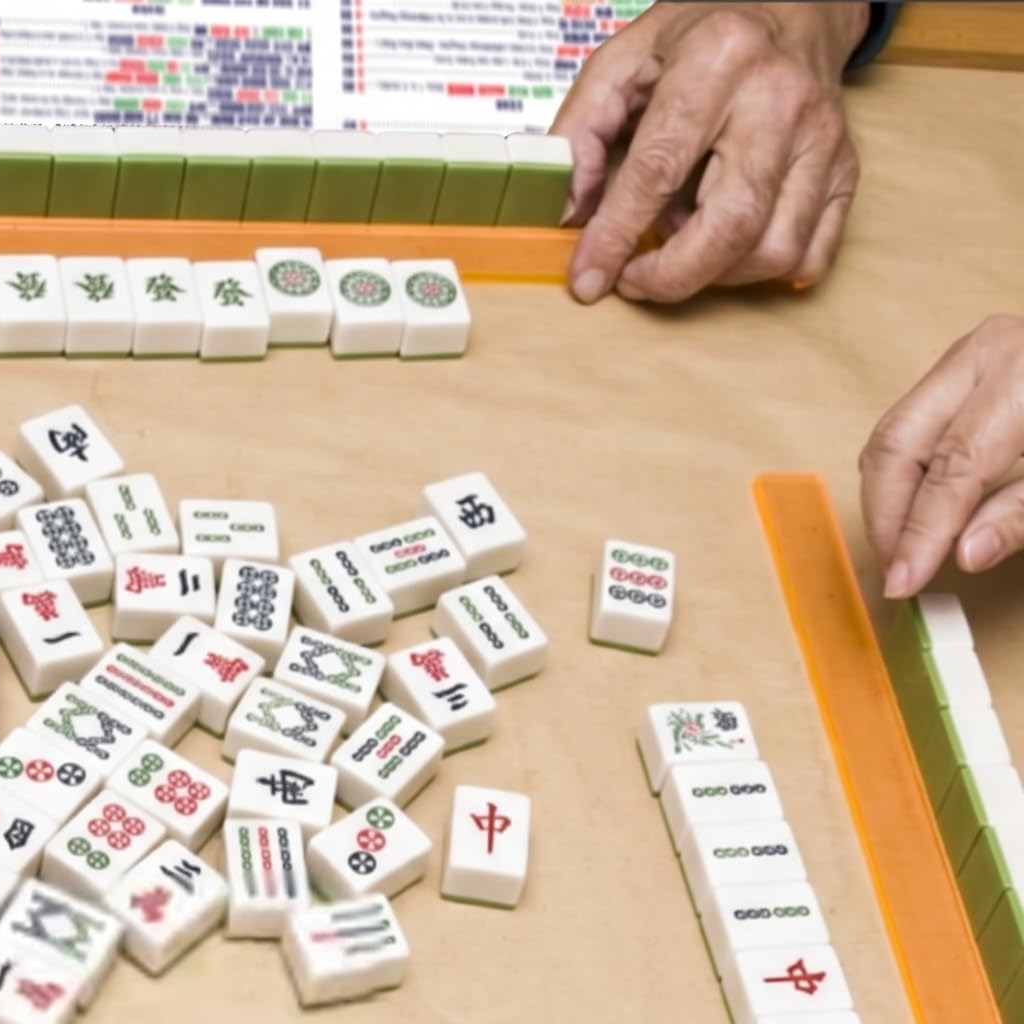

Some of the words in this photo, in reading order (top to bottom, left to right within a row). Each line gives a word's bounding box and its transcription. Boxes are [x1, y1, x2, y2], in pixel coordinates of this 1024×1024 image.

[49, 424, 87, 461] 南
[457, 495, 494, 528] 西
[472, 803, 510, 853] 中
[764, 960, 825, 994] 中
